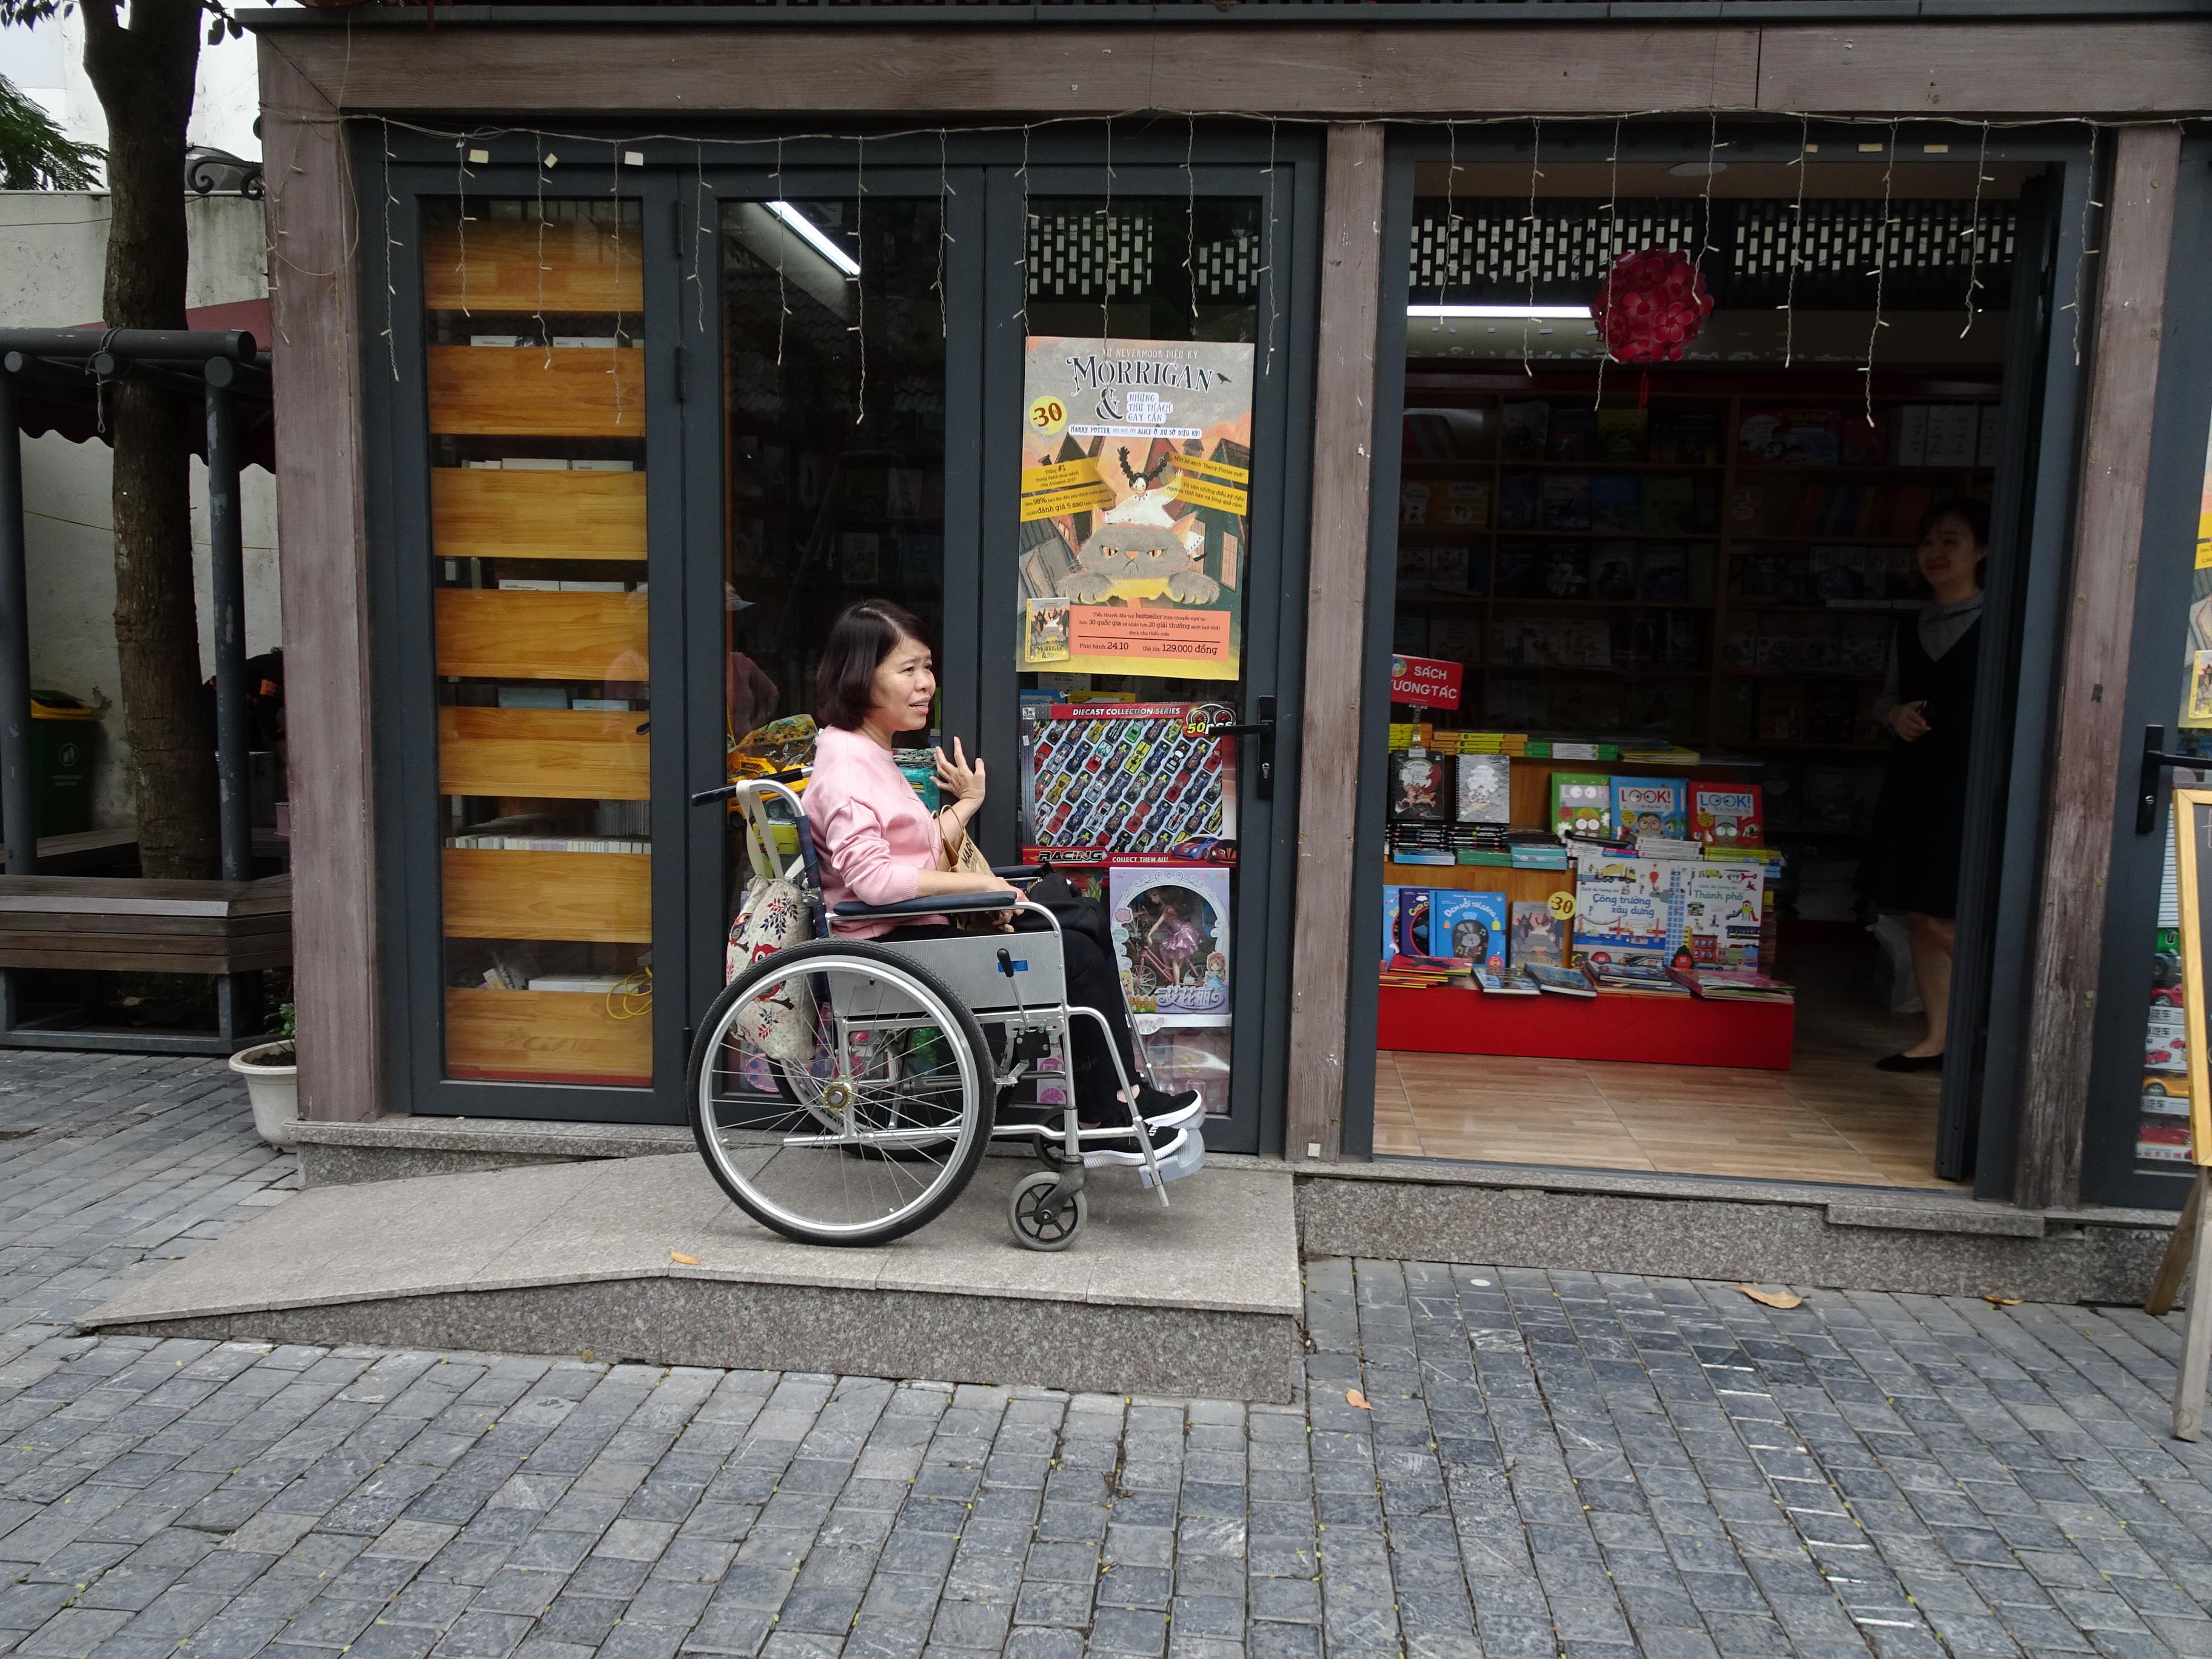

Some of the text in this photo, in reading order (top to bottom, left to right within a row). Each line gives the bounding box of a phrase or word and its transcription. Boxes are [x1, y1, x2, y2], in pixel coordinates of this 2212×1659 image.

[1116, 349, 1162, 358] NEVERMOOR
[1166, 349, 1184, 359] DIỆU
[1066, 355, 1215, 396] MORRIGAN
[1096, 387, 1124, 420] &
[1129, 394, 1155, 402] NHỮNG
[1129, 403, 1171, 412] THỬ THÁCH
[1128, 413, 1144, 421] GAY
[1218, 466, 1233, 475] Potter
[1200, 486, 1216, 496] những
[1033, 497, 1047, 505] 98%
[1037, 506, 1054, 514] đánh
[1055, 503, 1065, 512] giá
[1107, 642, 1129, 650] 24.10
[1162, 644, 1193, 652] 129.000
[1195, 643, 1218, 655] đồng
[1414, 666, 1447, 680] SÁCH
[1391, 680, 1458, 699] ƯƠNG TÁC
[1621, 789, 1671, 803] LOOK!
[1700, 794, 1751, 808] LOOK!
[1038, 850, 1103, 862] RACING
[1593, 893, 1618, 905] Công
[1694, 889, 1744, 905] Thành phố
[1611, 905, 1655, 918] xây dựng
